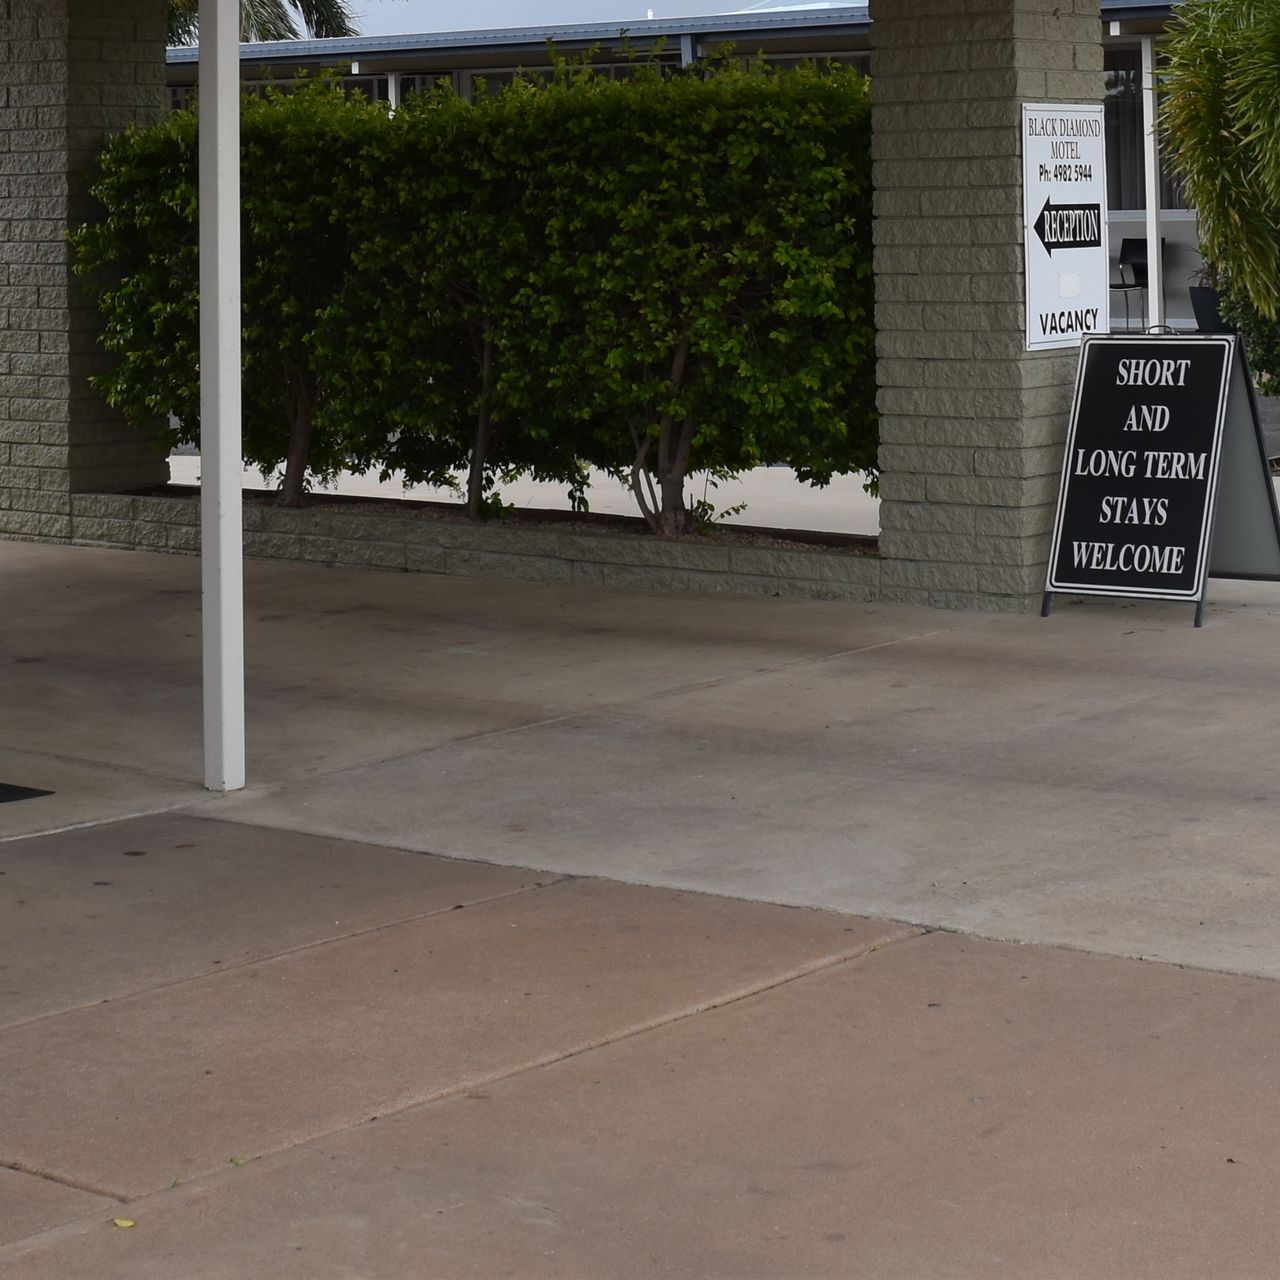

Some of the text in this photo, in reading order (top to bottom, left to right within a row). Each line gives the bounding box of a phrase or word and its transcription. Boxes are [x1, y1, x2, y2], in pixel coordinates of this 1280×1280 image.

[1028, 118, 1101, 137] BLACK DIAMOND
[1051, 141, 1081, 160] MOTEL
[1039, 163, 1092, 182] Ph: 4982 5944
[1043, 210, 1098, 242] RECEPTION
[1040, 308, 1098, 335] VACANCY
[1116, 358, 1191, 386] SHORT
[1123, 405, 1170, 432] AND
[1074, 449, 1207, 480] LONG TERM
[1099, 496, 1169, 526] STAYS
[1072, 541, 1185, 575] WELCOME
